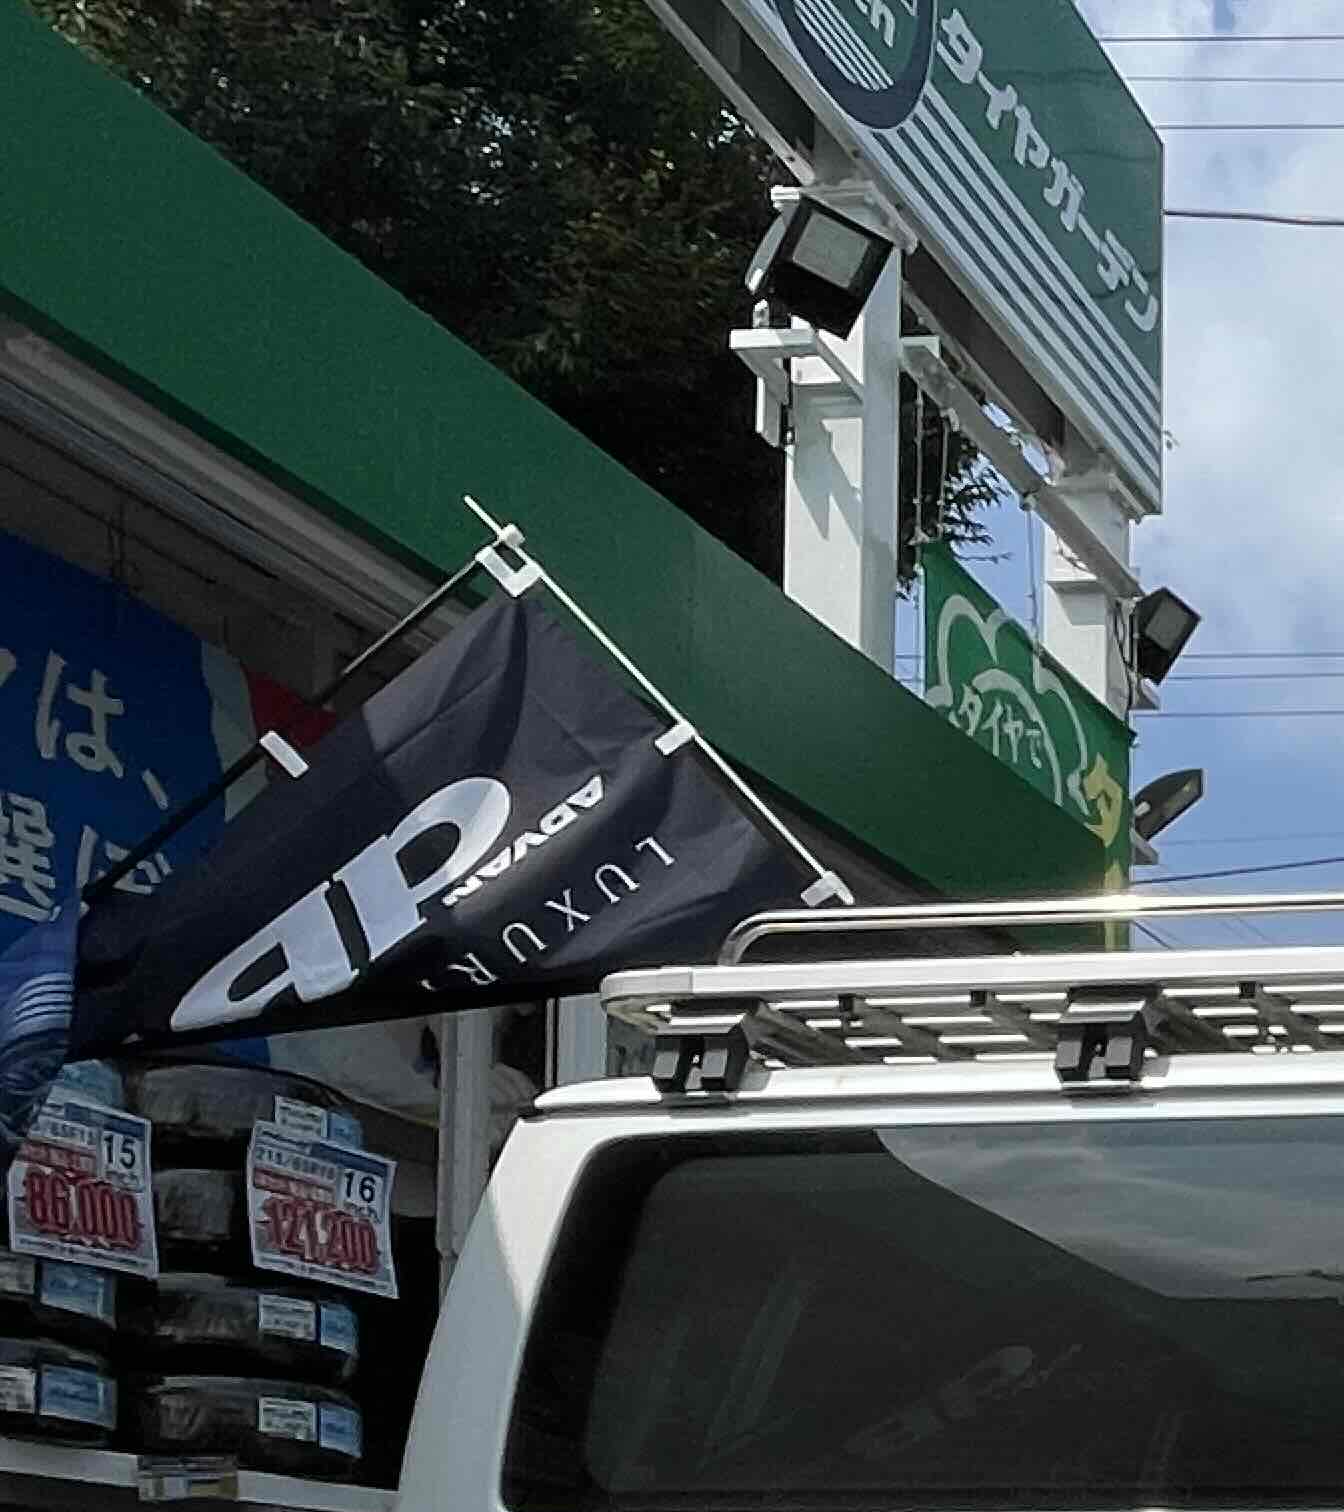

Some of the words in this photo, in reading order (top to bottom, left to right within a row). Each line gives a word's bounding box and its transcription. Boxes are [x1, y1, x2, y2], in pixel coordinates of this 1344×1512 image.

[441, 775, 604, 906] ADVAN
[420, 836, 676, 991] LUXUR
[104, 1134, 137, 1169] 15
[344, 1171, 377, 1203] 16
